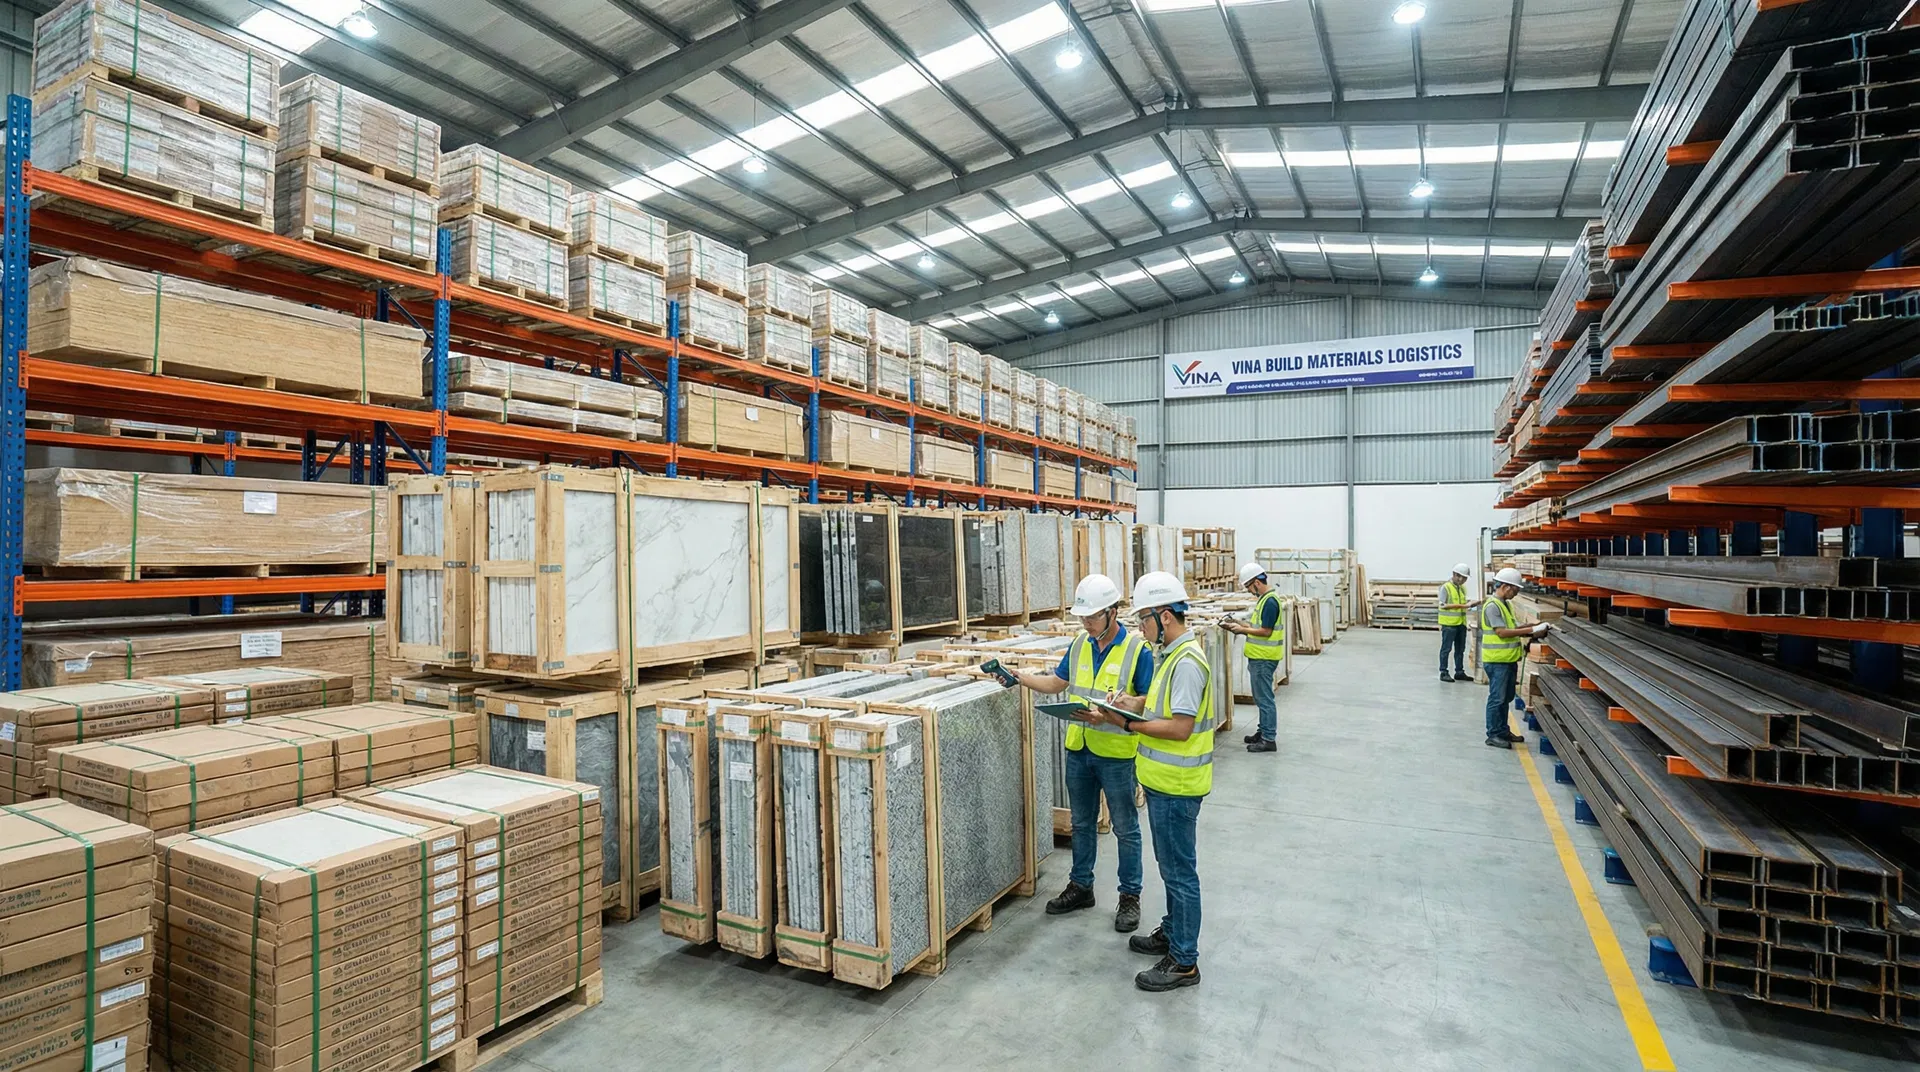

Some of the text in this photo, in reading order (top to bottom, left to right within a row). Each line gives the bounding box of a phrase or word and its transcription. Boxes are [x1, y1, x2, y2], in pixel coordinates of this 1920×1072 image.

[1172, 360, 1222, 385] VINA
[1232, 344, 1462, 375] VINA BUILD MATERIALS LOGISTICS
